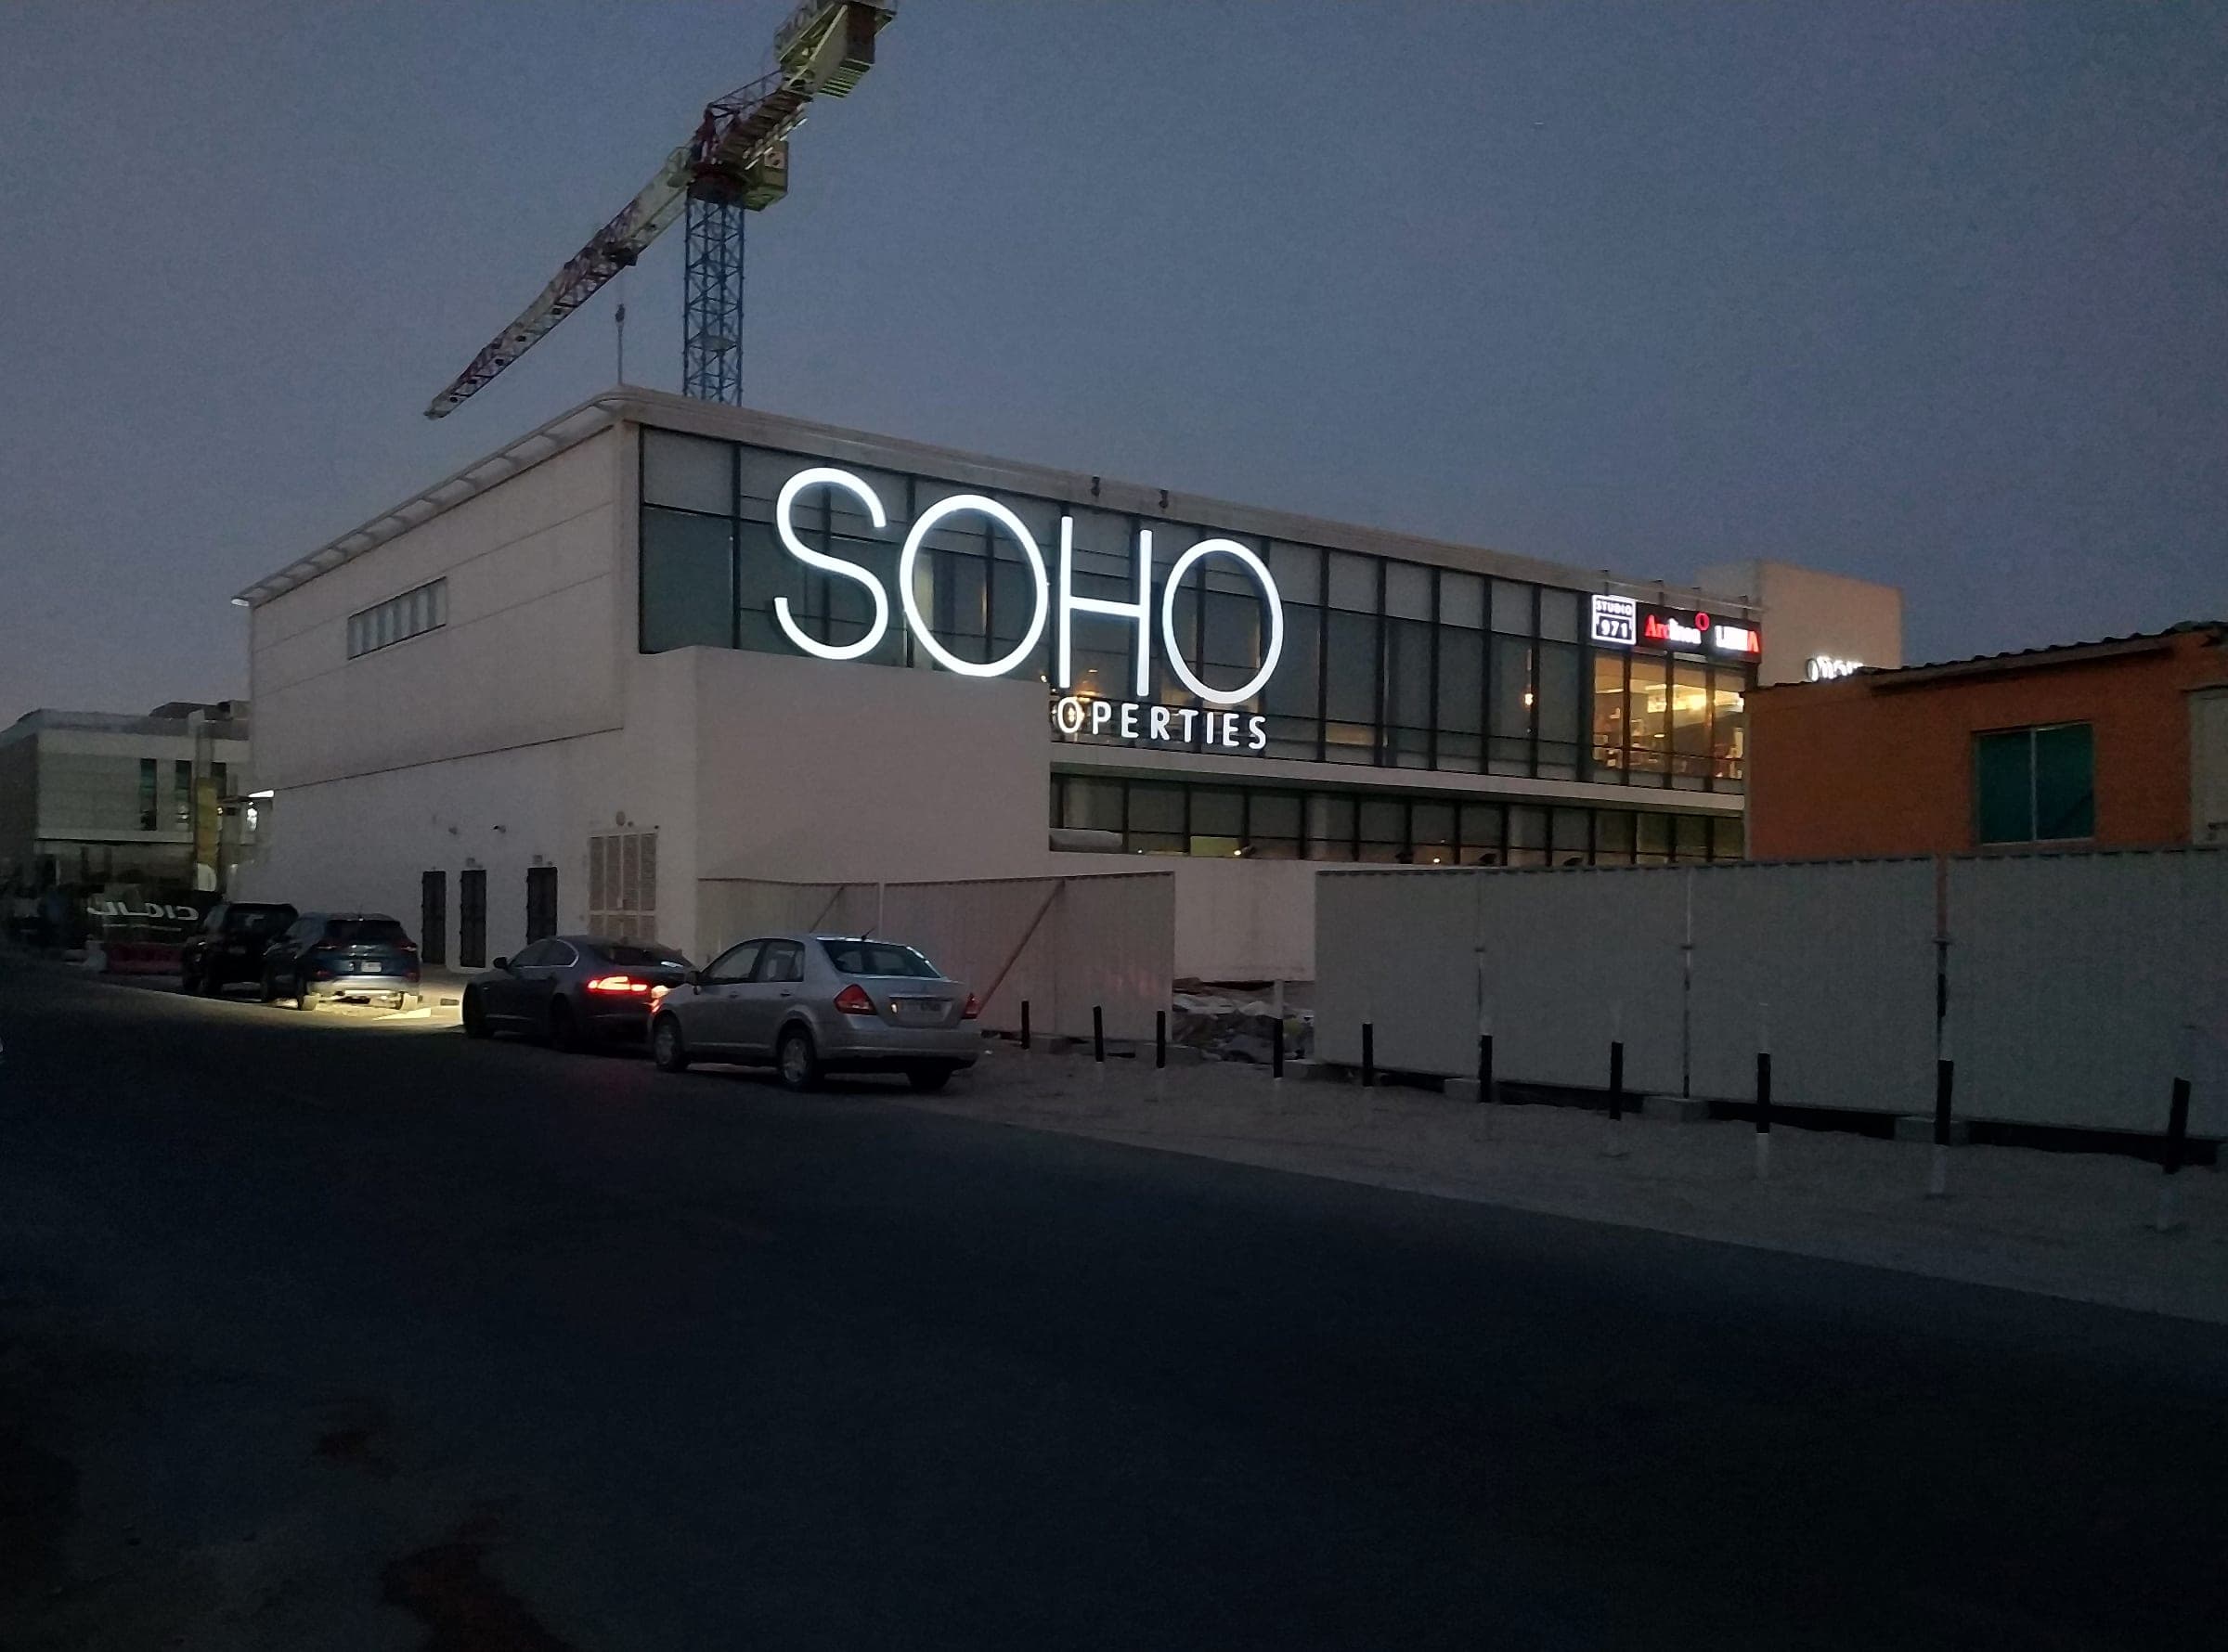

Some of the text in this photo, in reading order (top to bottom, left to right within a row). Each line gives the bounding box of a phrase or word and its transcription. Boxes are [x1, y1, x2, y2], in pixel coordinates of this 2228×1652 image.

[774, 467, 1284, 703] SOHO
[1596, 600, 1632, 615] STUDIO
[1601, 619, 1627, 638] 971
